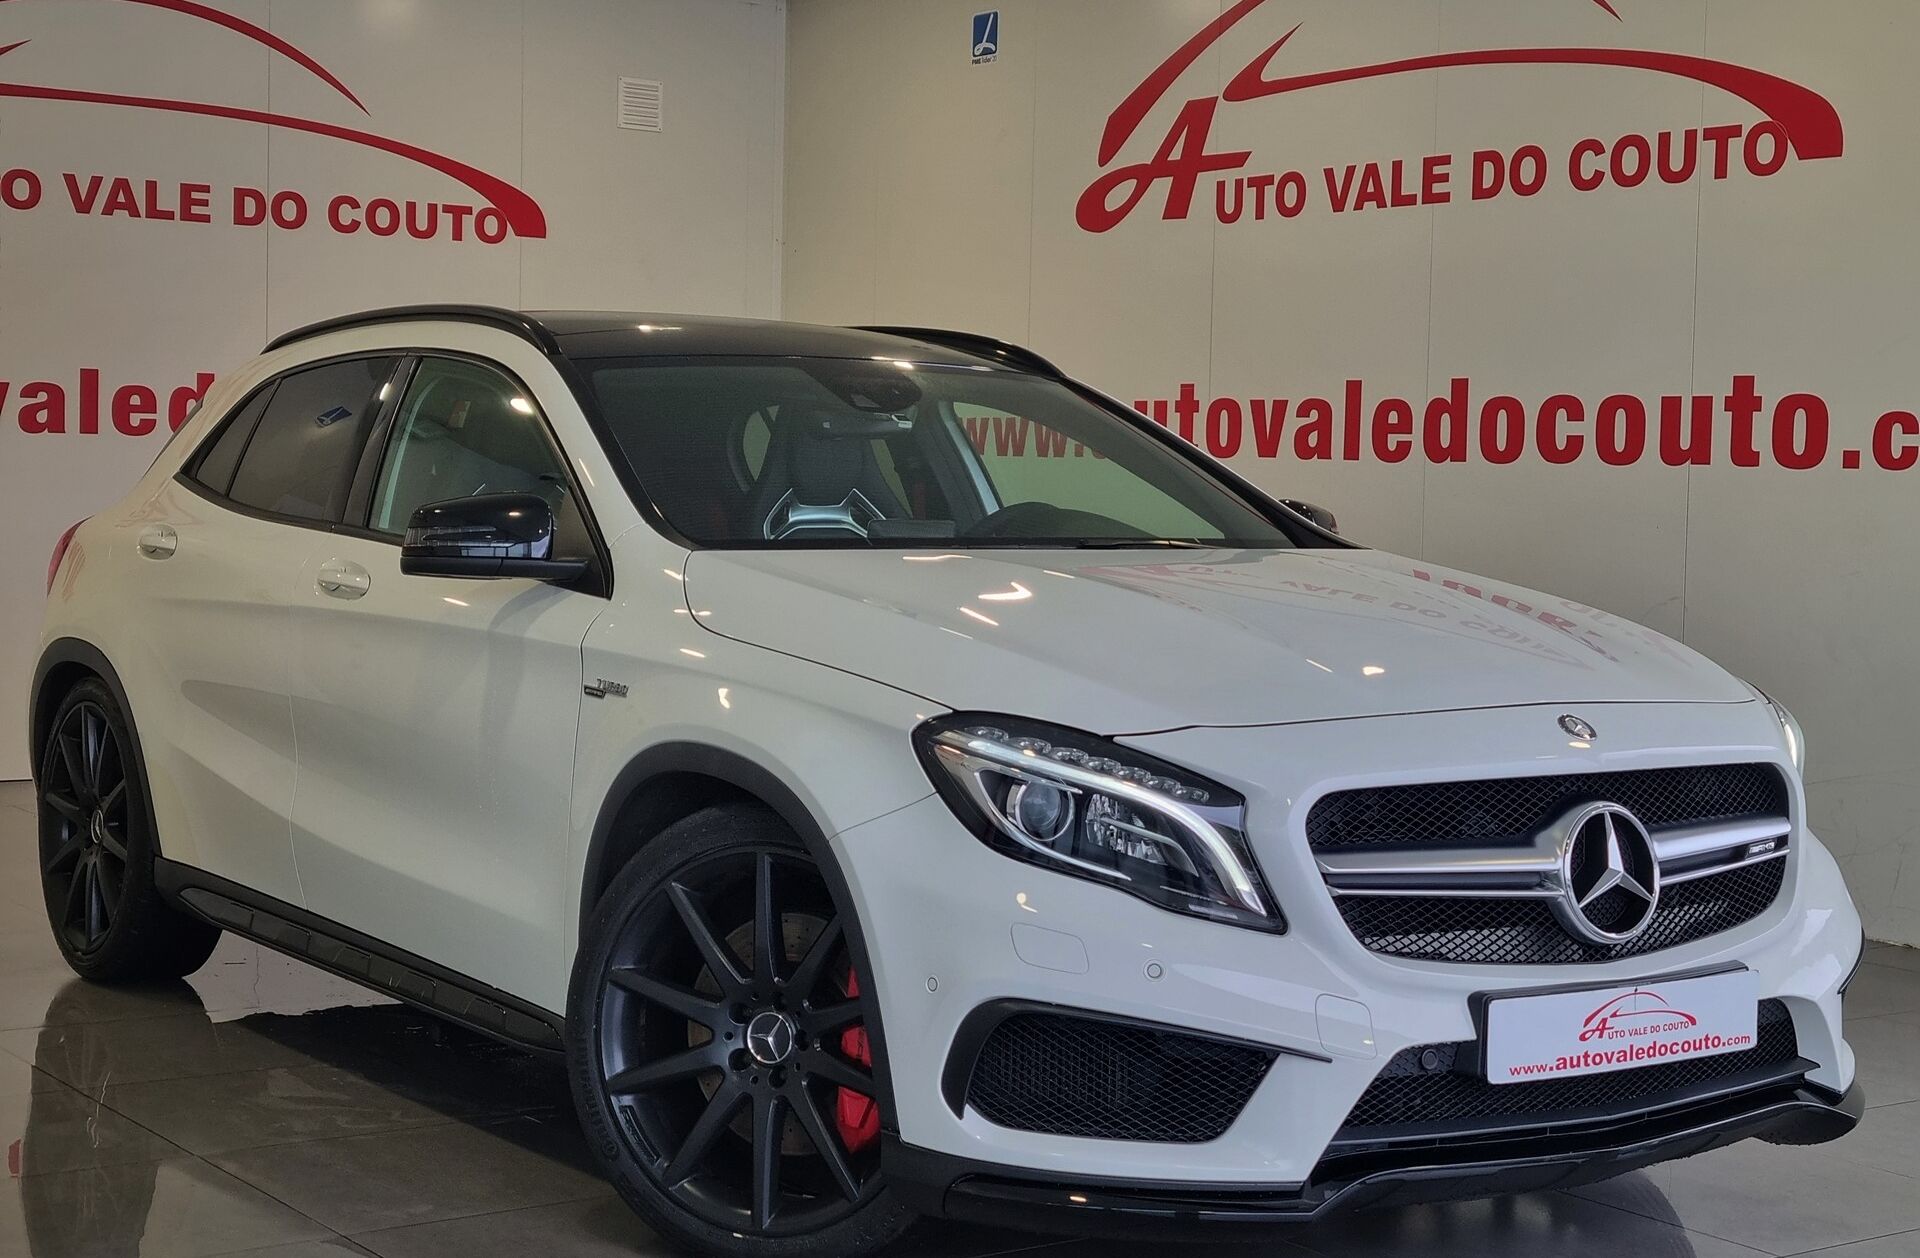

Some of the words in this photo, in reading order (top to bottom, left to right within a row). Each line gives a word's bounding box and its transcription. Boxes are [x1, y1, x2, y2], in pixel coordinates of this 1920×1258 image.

[1075, 96, 1307, 234] AUTO
[1323, 154, 1453, 214] VALE
[1471, 144, 1548, 201] DO
[1568, 120, 1789, 192] COUTO
[62, 172, 212, 224] VALE
[232, 187, 308, 231] DO
[327, 194, 508, 245] COUTO
[1509, 1033, 1751, 1077] www.autovaledocouto.com
[1579, 1016, 1626, 1042] AUTO
[1628, 1026, 1648, 1037] VALE
[1650, 1024, 1661, 1035] DO
[1663, 1020, 1690, 1032] COUTO
